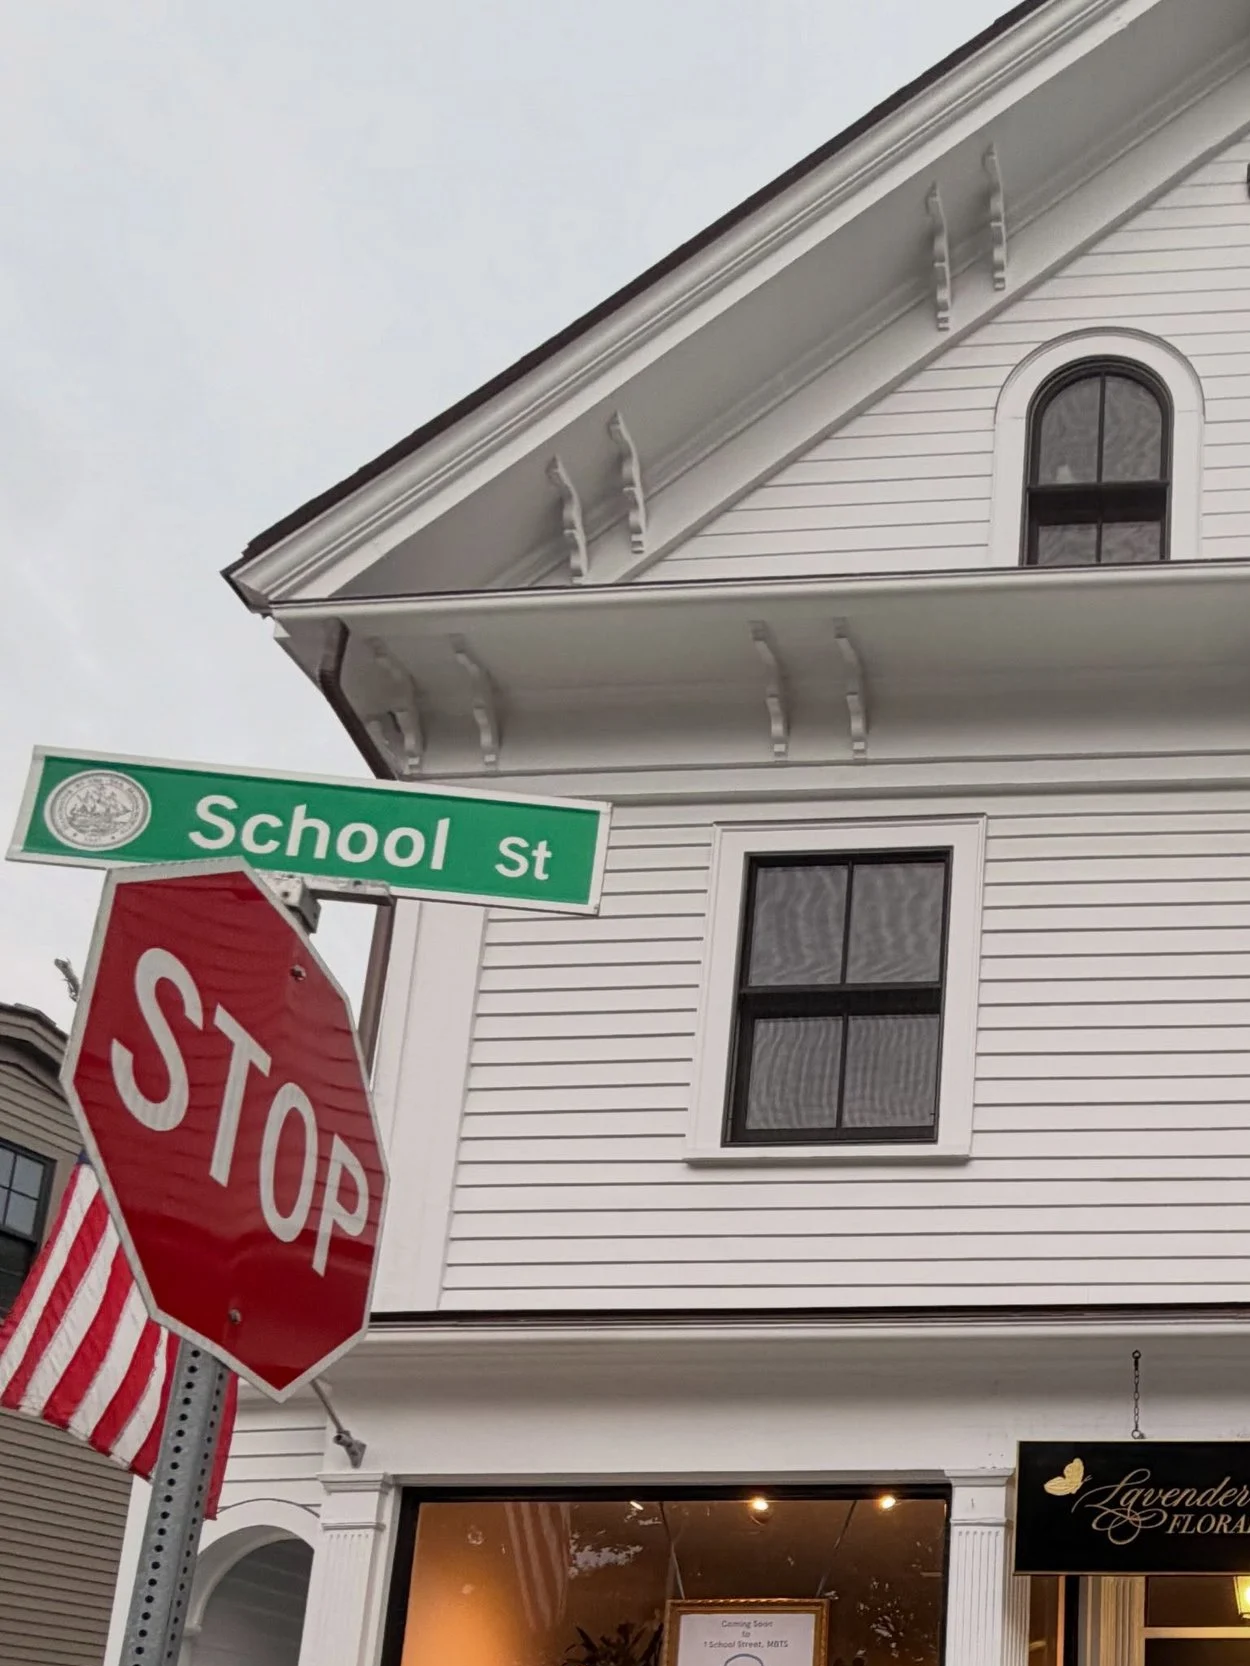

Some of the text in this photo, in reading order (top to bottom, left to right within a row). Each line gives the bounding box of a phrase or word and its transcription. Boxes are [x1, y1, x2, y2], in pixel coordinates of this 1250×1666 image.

[188, 794, 450, 871] School
[494, 836, 553, 881] St
[111, 947, 369, 1277] STOP
[722, 1620, 752, 1629] Coming
[737, 1640, 764, 1648] Street,
